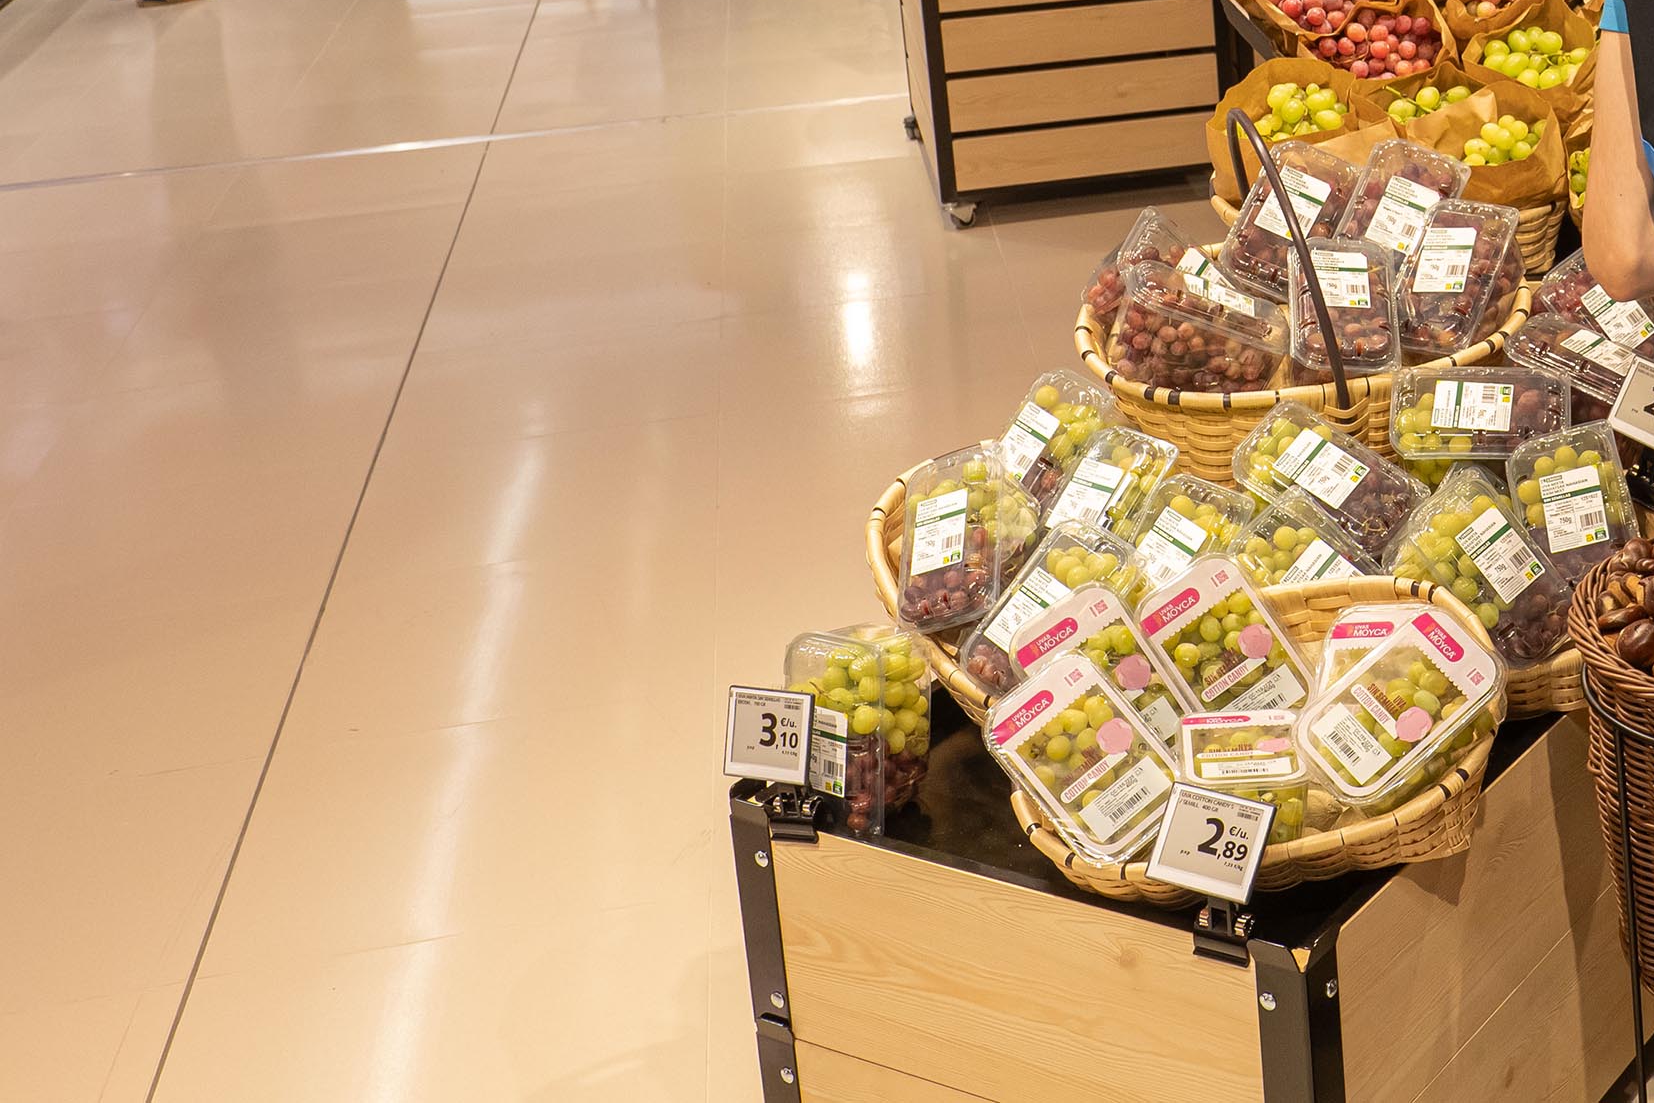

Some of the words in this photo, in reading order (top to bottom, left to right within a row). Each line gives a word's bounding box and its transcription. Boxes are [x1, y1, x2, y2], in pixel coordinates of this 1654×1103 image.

[1162, 595, 1196, 624] MOYCA
[1039, 626, 1074, 653] MOYCA
[1353, 628, 1389, 637] MOYCA
[1428, 631, 1457, 660] MOYCA
[1204, 679, 1228, 699] COTTON
[1228, 664, 1250, 684] CANDY
[1015, 697, 1050, 728] MOYCA
[1353, 686, 1373, 708] COTTON
[1370, 704, 1391, 725] CANDY
[759, 712, 799, 750] 3,10
[780, 717, 797, 729] €/u.
[1064, 777, 1089, 801] COTTON
[1088, 760, 1111, 784] CANDY
[1193, 794, 1214, 805] COTTON
[1213, 799, 1231, 809] CANDY
[1197, 817, 1248, 862] 2,89
[1229, 825, 1249, 840] €/u.
